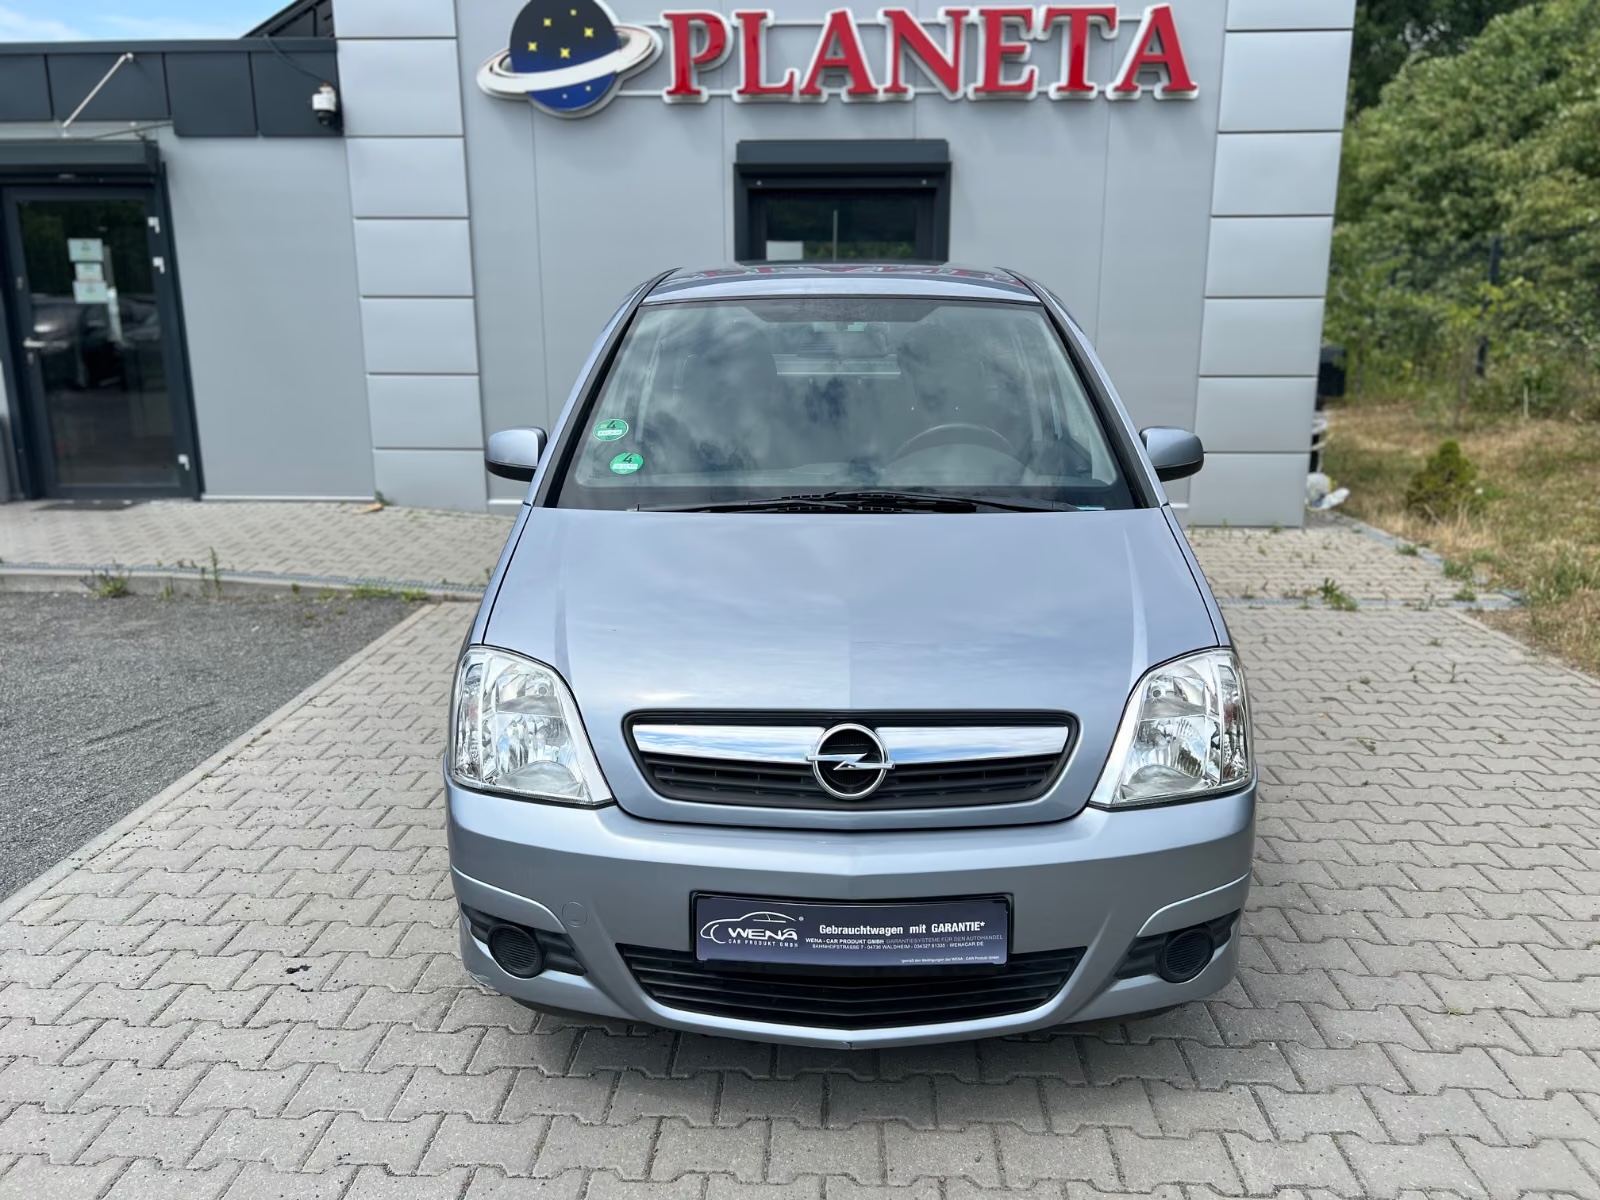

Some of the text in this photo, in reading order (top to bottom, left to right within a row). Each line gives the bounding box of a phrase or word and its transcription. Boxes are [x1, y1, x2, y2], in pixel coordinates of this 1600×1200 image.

[660, 4, 1199, 103] PLANETA
[607, 420, 616, 429] 4
[623, 453, 632, 463] 4
[728, 928, 798, 941] WENA
[819, 924, 904, 936] Gebrauchtwagen
[909, 923, 926, 934] mit
